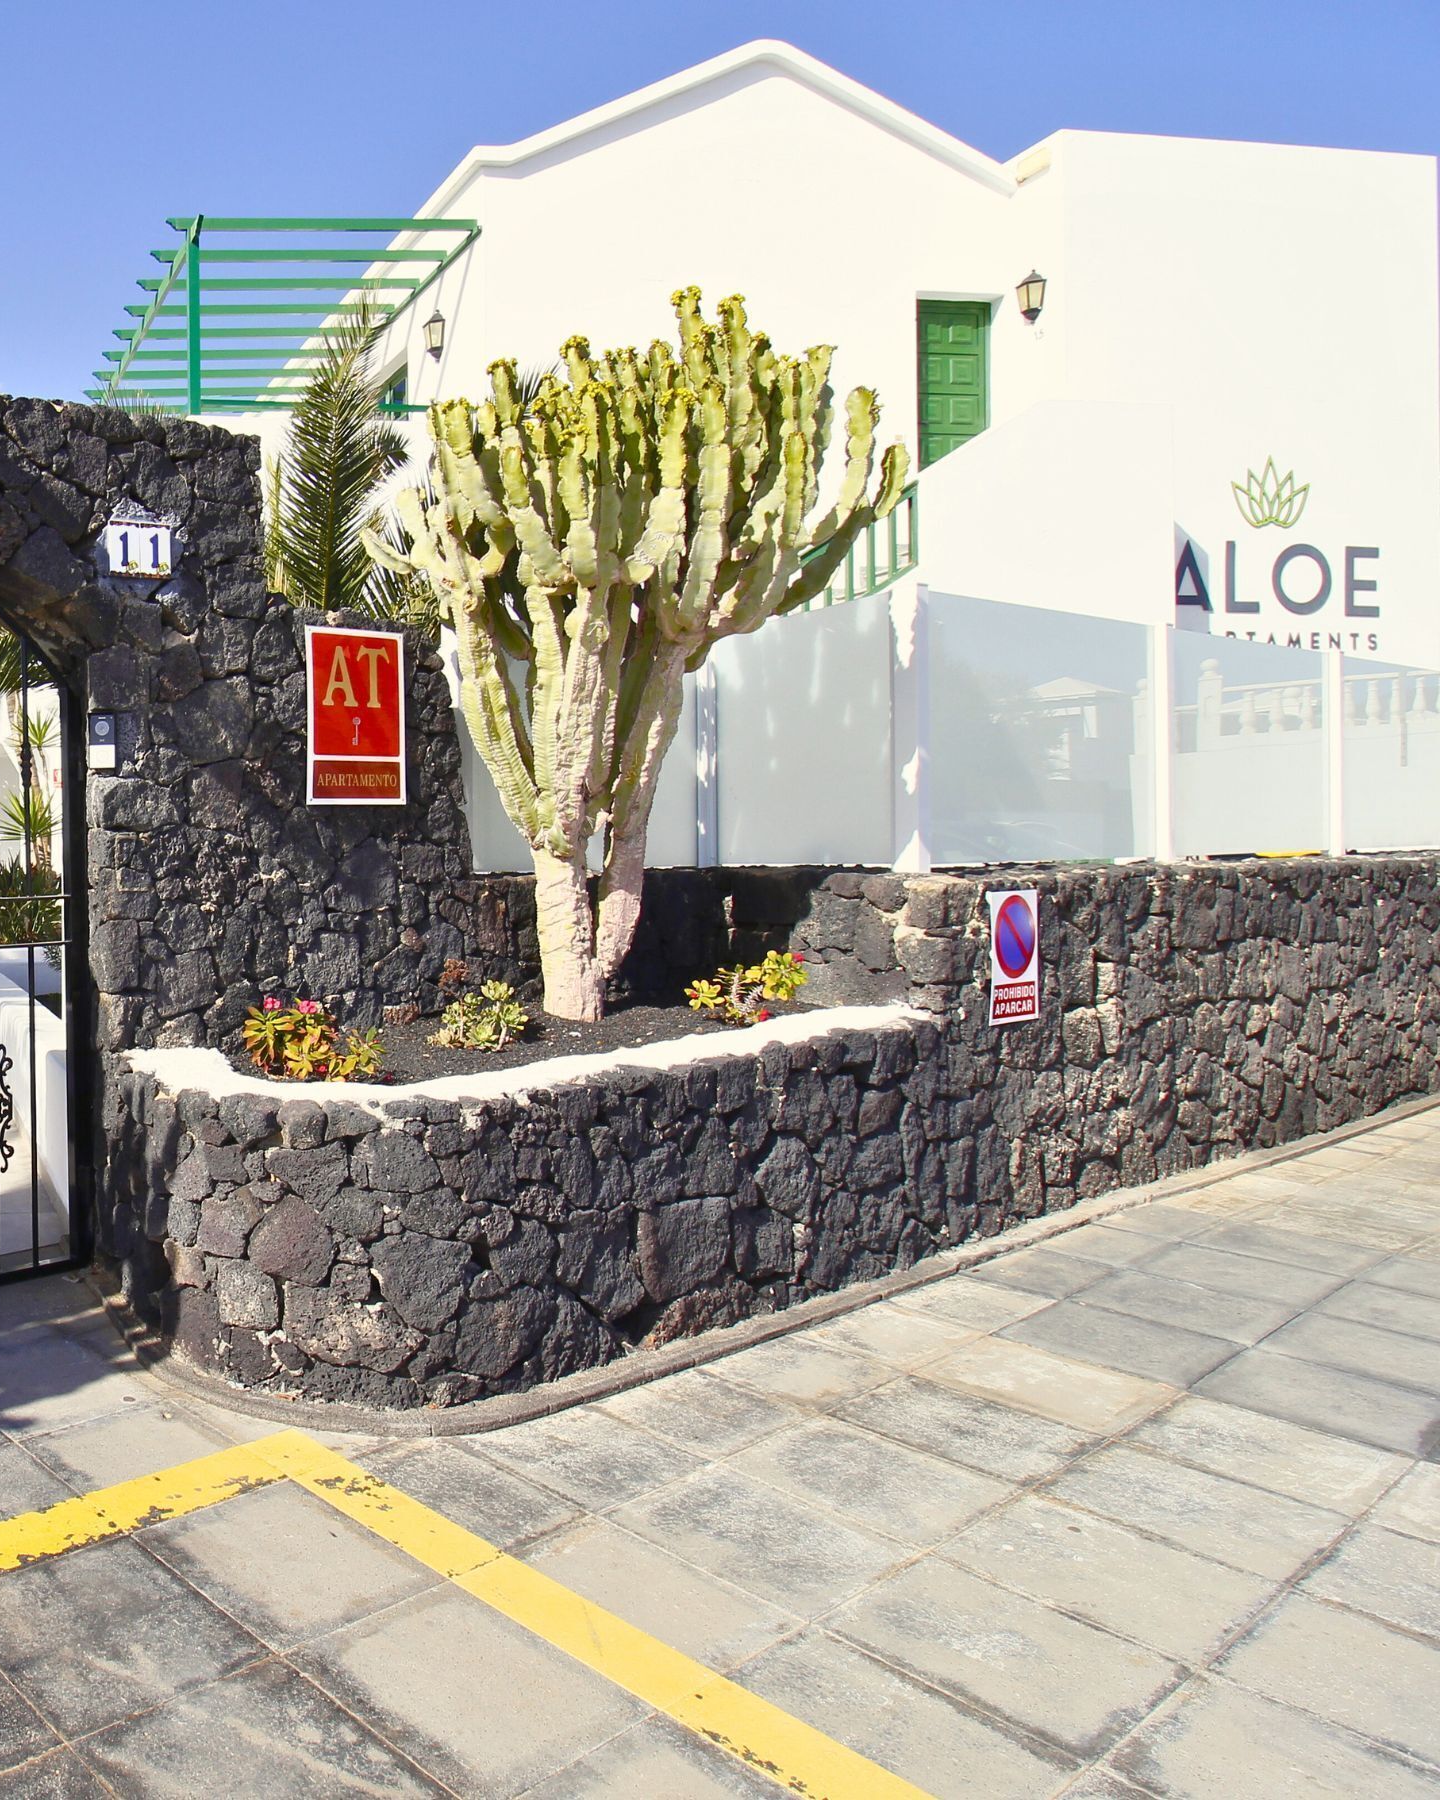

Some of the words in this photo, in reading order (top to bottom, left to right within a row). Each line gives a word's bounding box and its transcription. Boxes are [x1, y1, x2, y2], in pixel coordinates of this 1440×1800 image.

[1174, 538, 1380, 618] ALOE
[321, 644, 390, 709] AT
[316, 772, 398, 789] APARTAMENTO
[993, 984, 1035, 1001] PROHIBIDO
[994, 999, 1033, 1016] APARCAR
